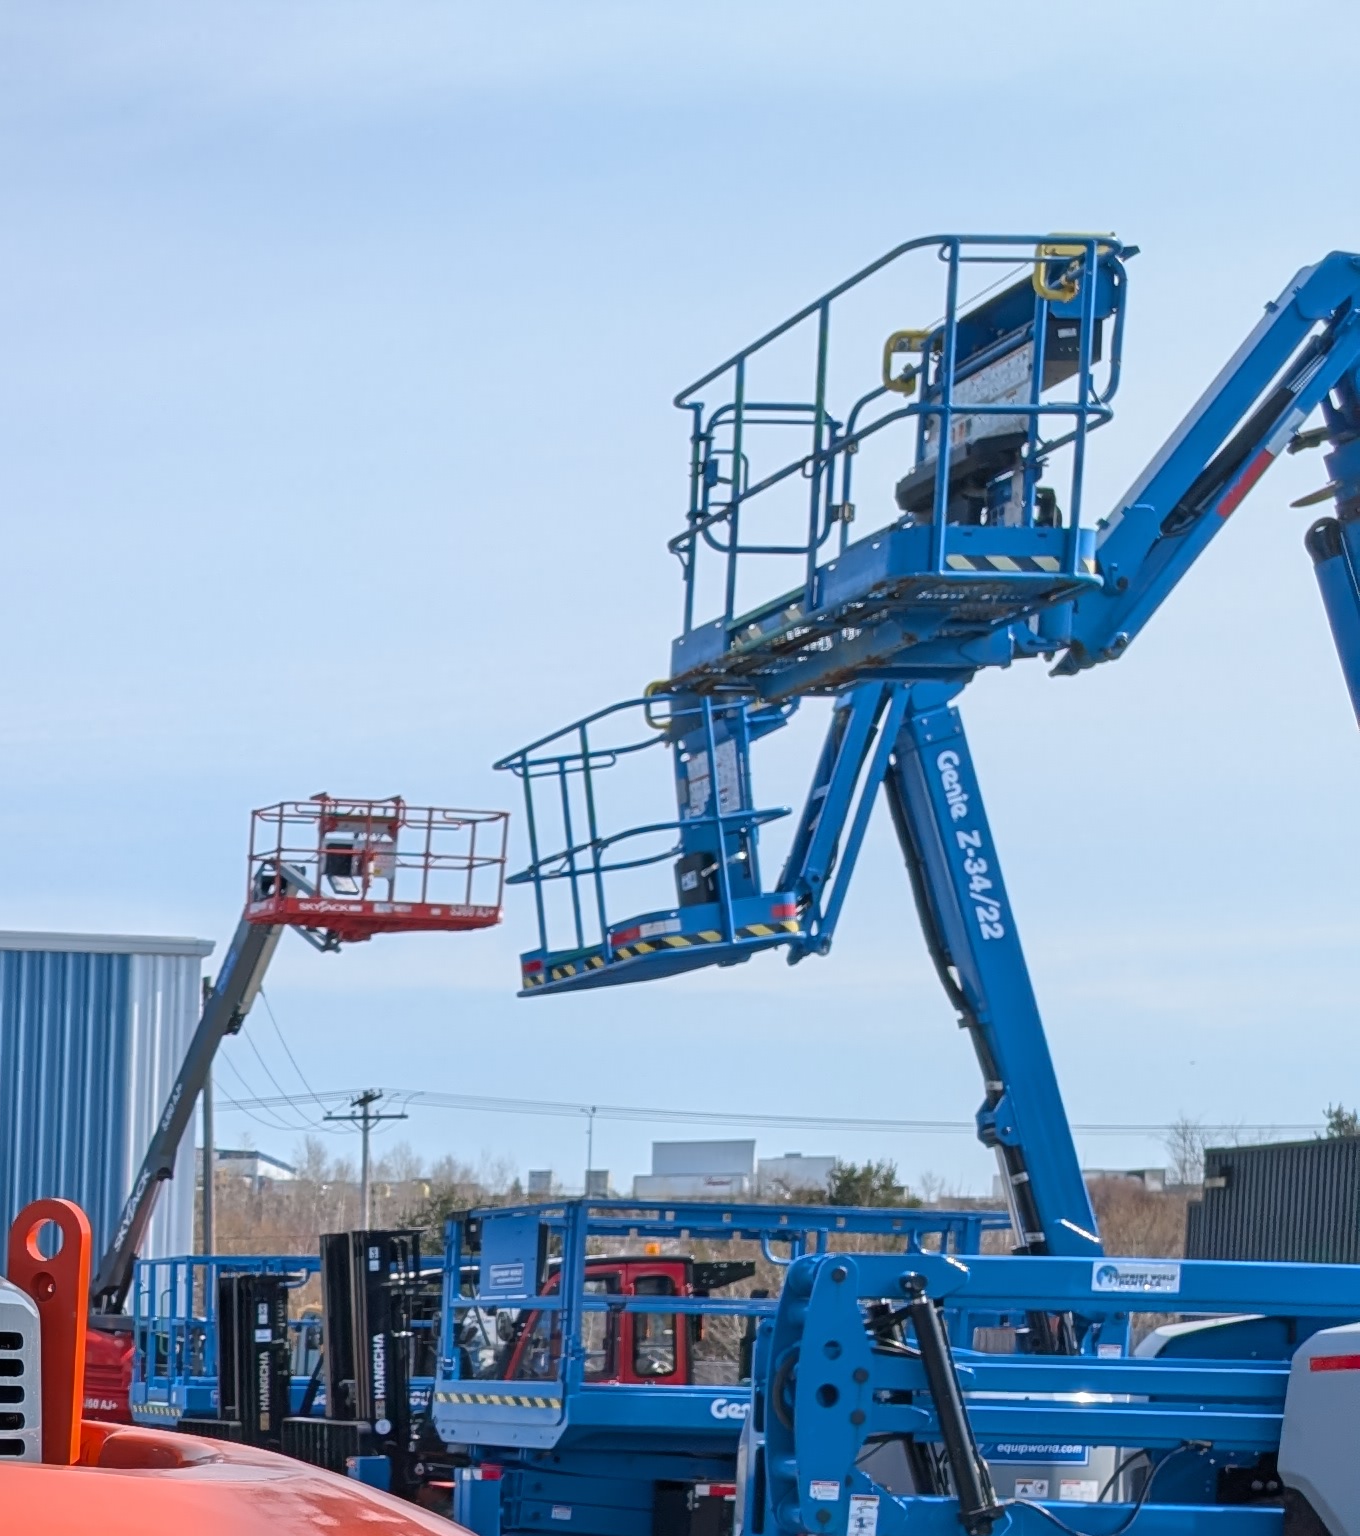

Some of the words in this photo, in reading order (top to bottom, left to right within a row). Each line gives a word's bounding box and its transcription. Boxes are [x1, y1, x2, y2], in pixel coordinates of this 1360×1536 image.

[937, 750, 969, 821] Genie
[956, 830, 1005, 940] Z-34/22
[113, 1168, 151, 1253] SKYJACK
[259, 1351, 271, 1411] HANGCHA
[373, 1333, 386, 1399] HANGCHA
